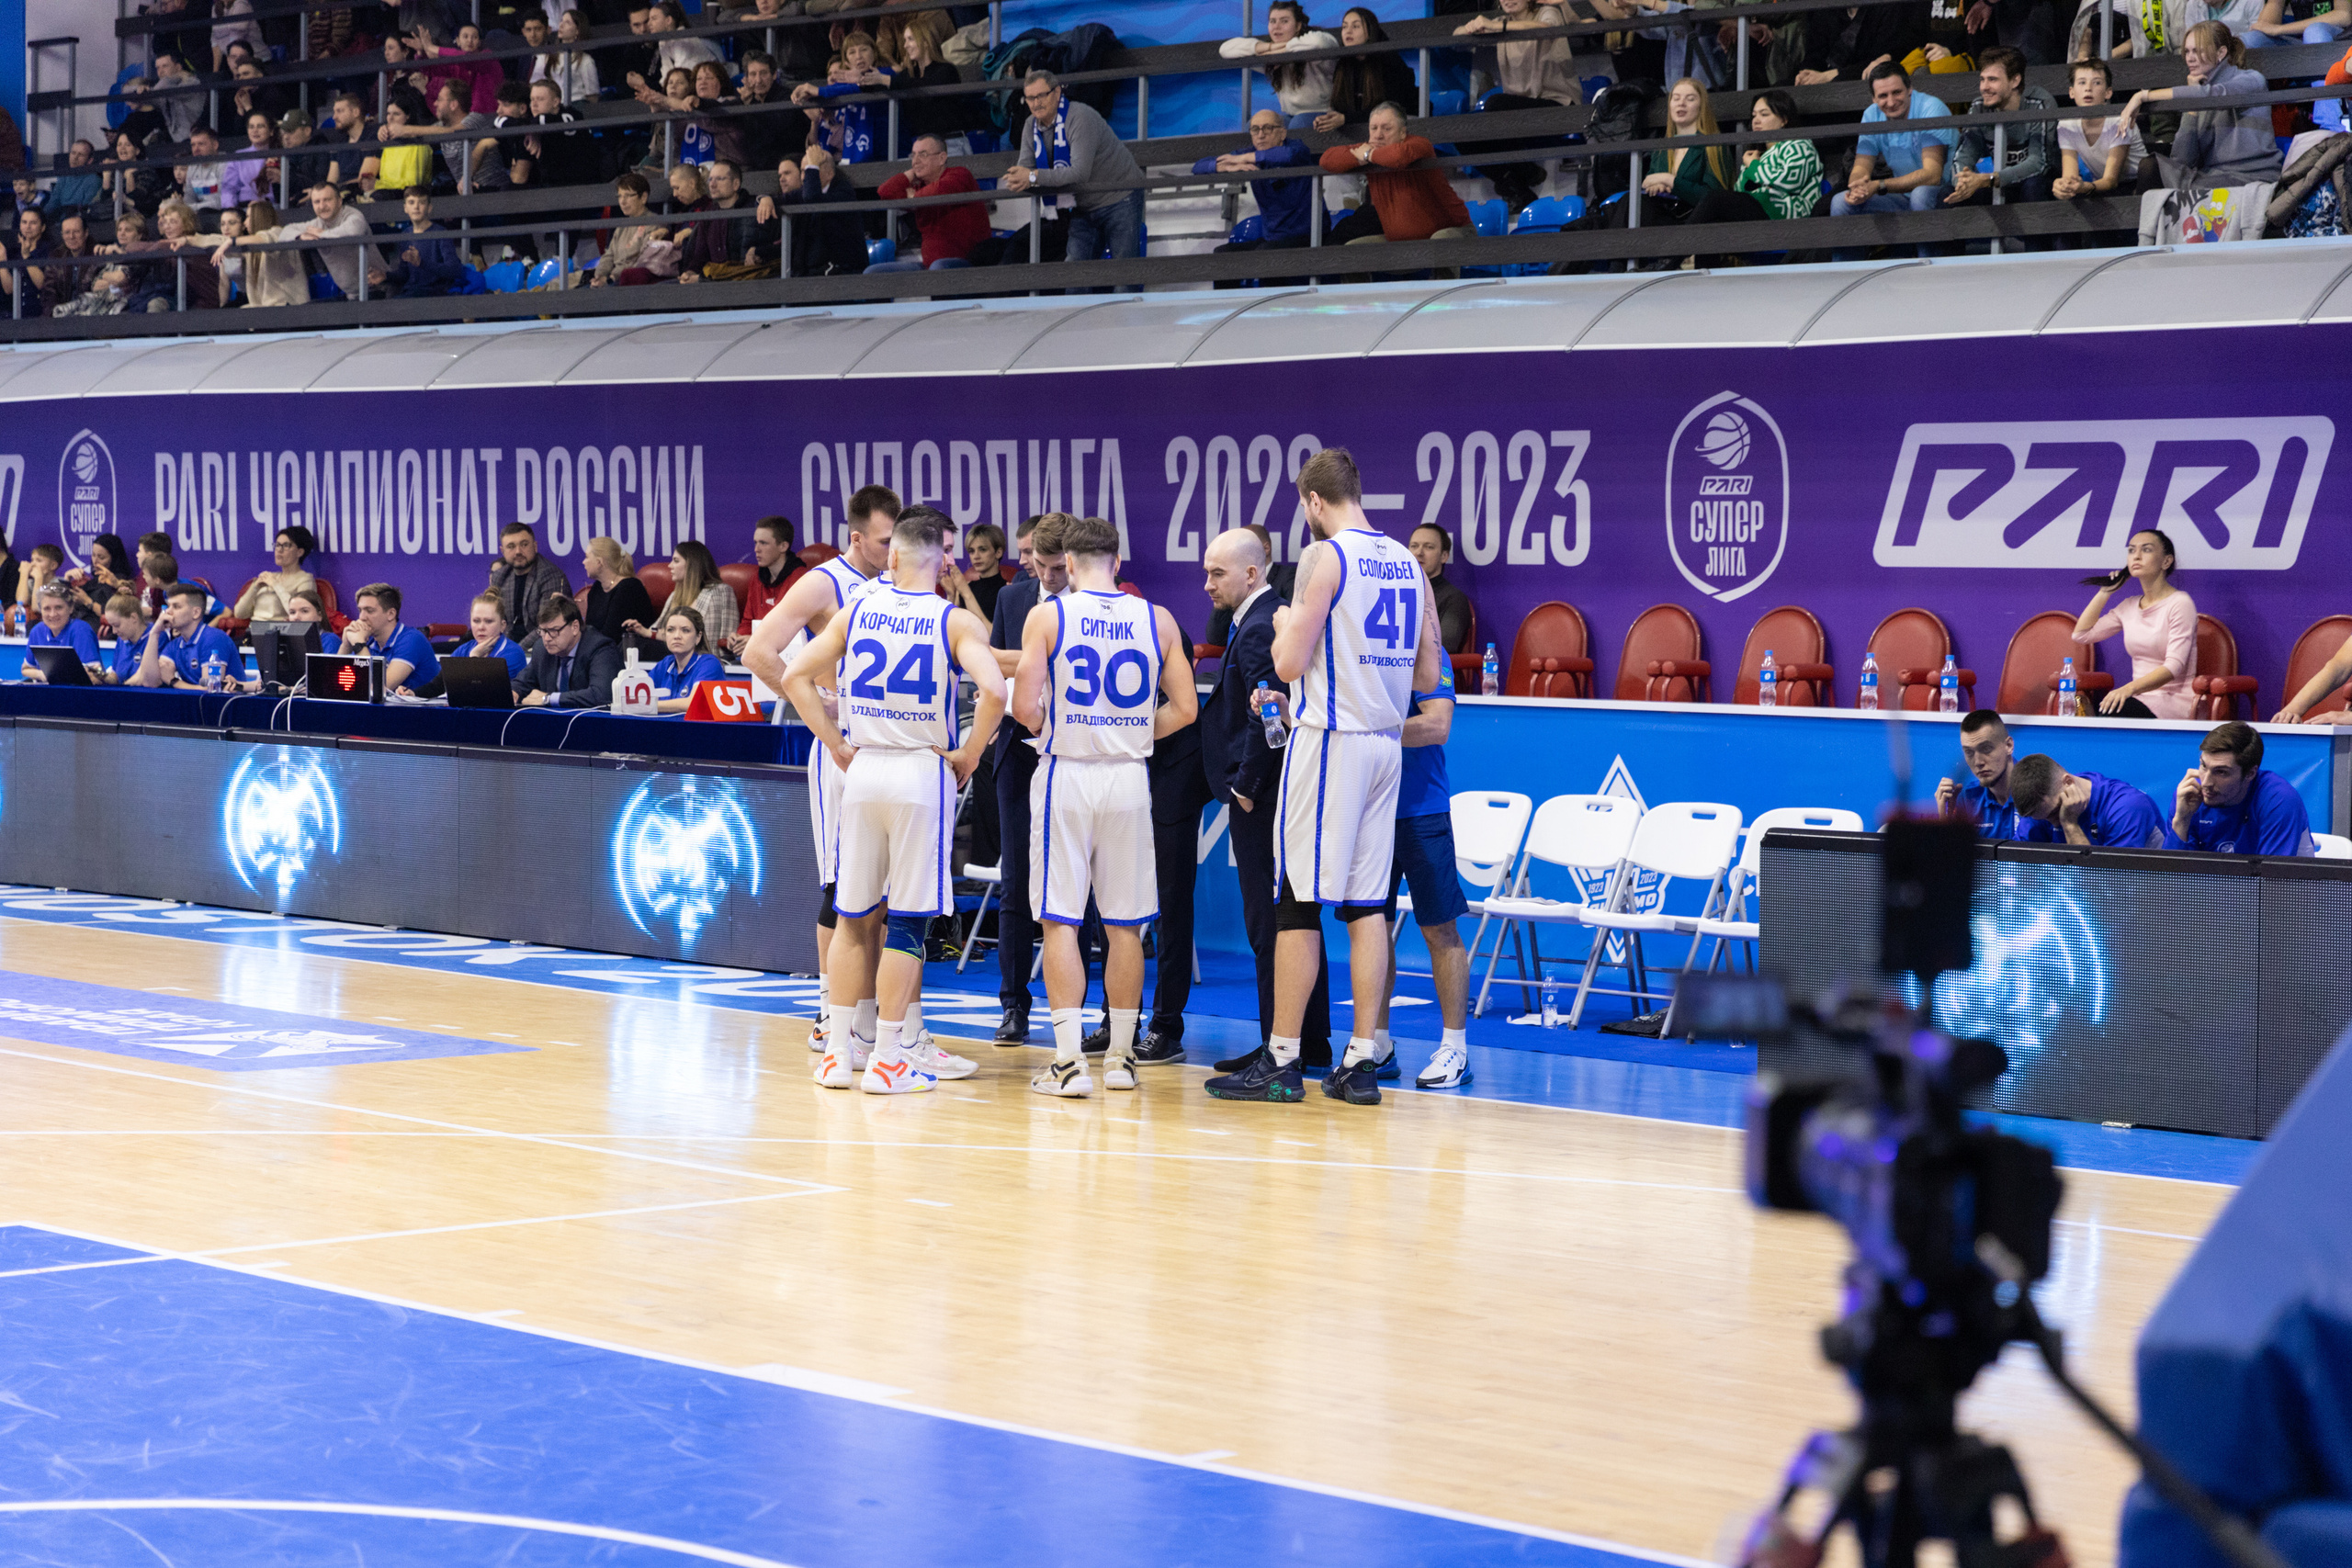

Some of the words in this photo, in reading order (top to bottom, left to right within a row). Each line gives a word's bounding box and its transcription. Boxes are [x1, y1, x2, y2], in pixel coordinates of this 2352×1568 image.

[154, 452, 238, 551] PARI
[515, 446, 706, 557] РОССИИ
[1892, 435, 2309, 550] PARI
[78, 535, 96, 556] ЛИГ
[1705, 547, 1747, 577] ЛИГА
[859, 612, 935, 636] КОРЧАГИН
[1081, 616, 1135, 640] СИТНИК
[1364, 588, 1418, 649] 41
[851, 638, 937, 705] 24
[1065, 644, 1150, 709] 30
[626, 682, 650, 705] 5
[712, 684, 756, 716] 5
[851, 705, 937, 722] ВЛАДИВОСТОК
[1588, 881, 1605, 895] 1923
